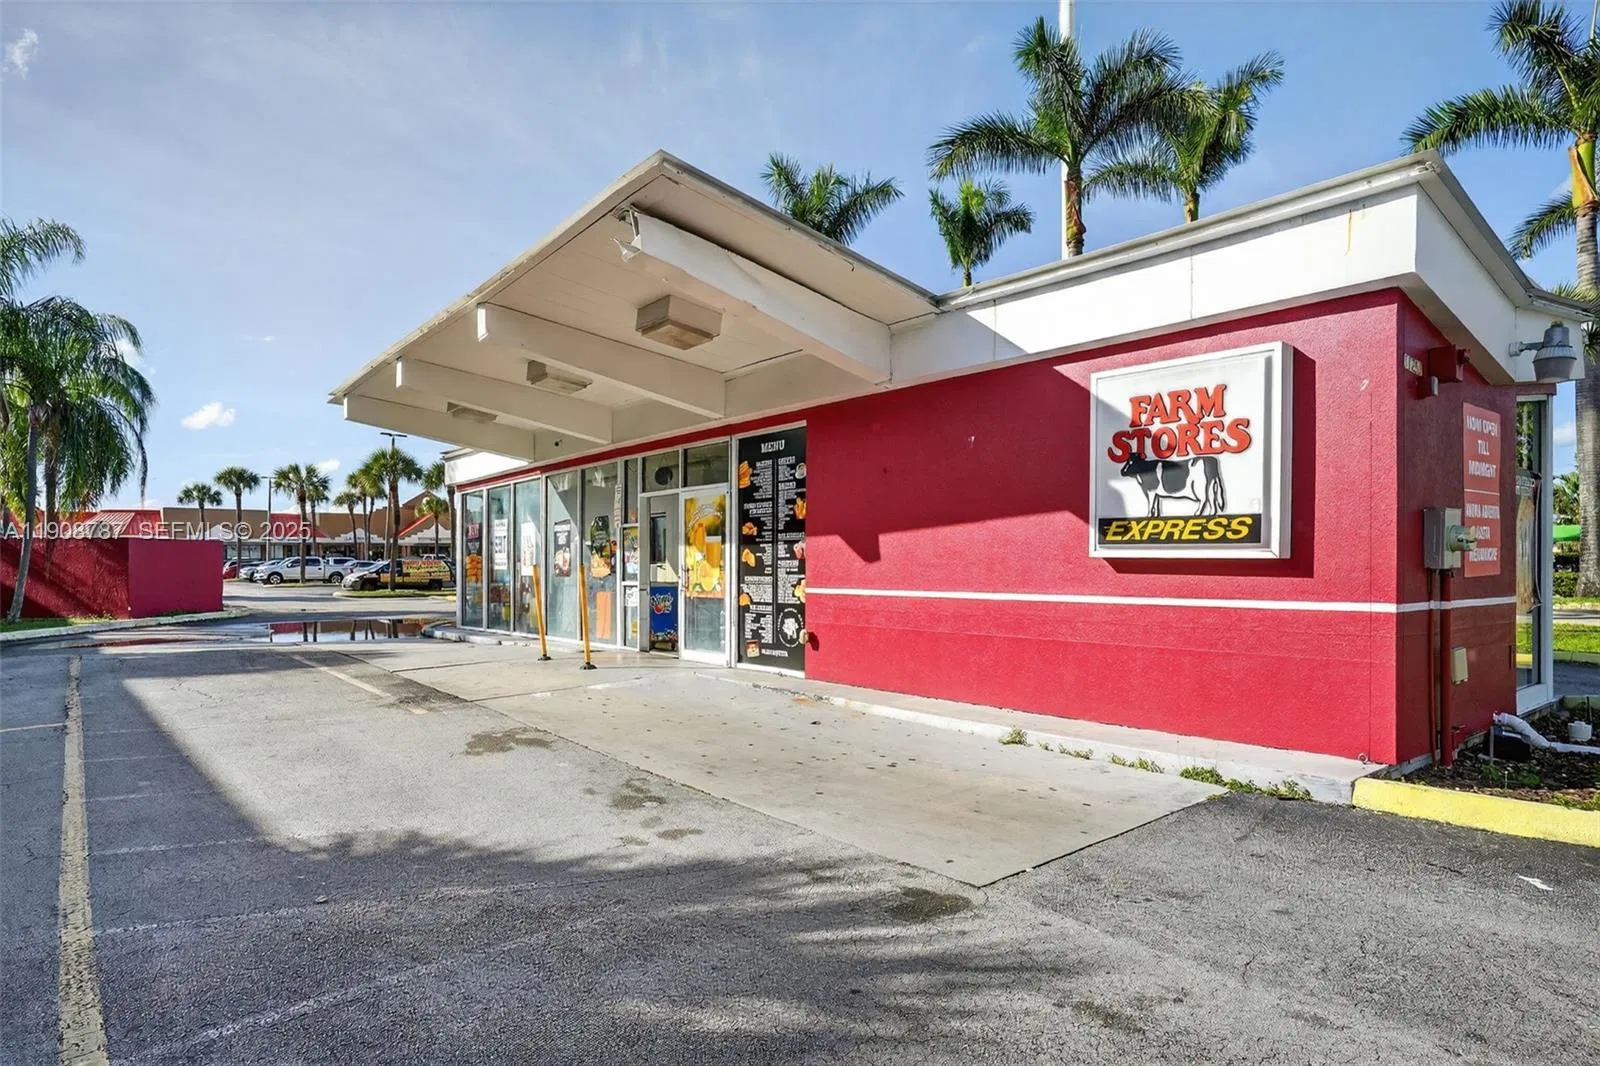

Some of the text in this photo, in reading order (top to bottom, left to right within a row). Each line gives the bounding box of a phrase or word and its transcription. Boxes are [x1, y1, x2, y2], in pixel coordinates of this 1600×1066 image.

[1129, 384, 1227, 428] FARM
[761, 440, 785, 453] MENU
[1108, 418, 1252, 464] STORES
[1477, 439, 1490, 456] TILL
[1105, 516, 1253, 541] EXPRESS
